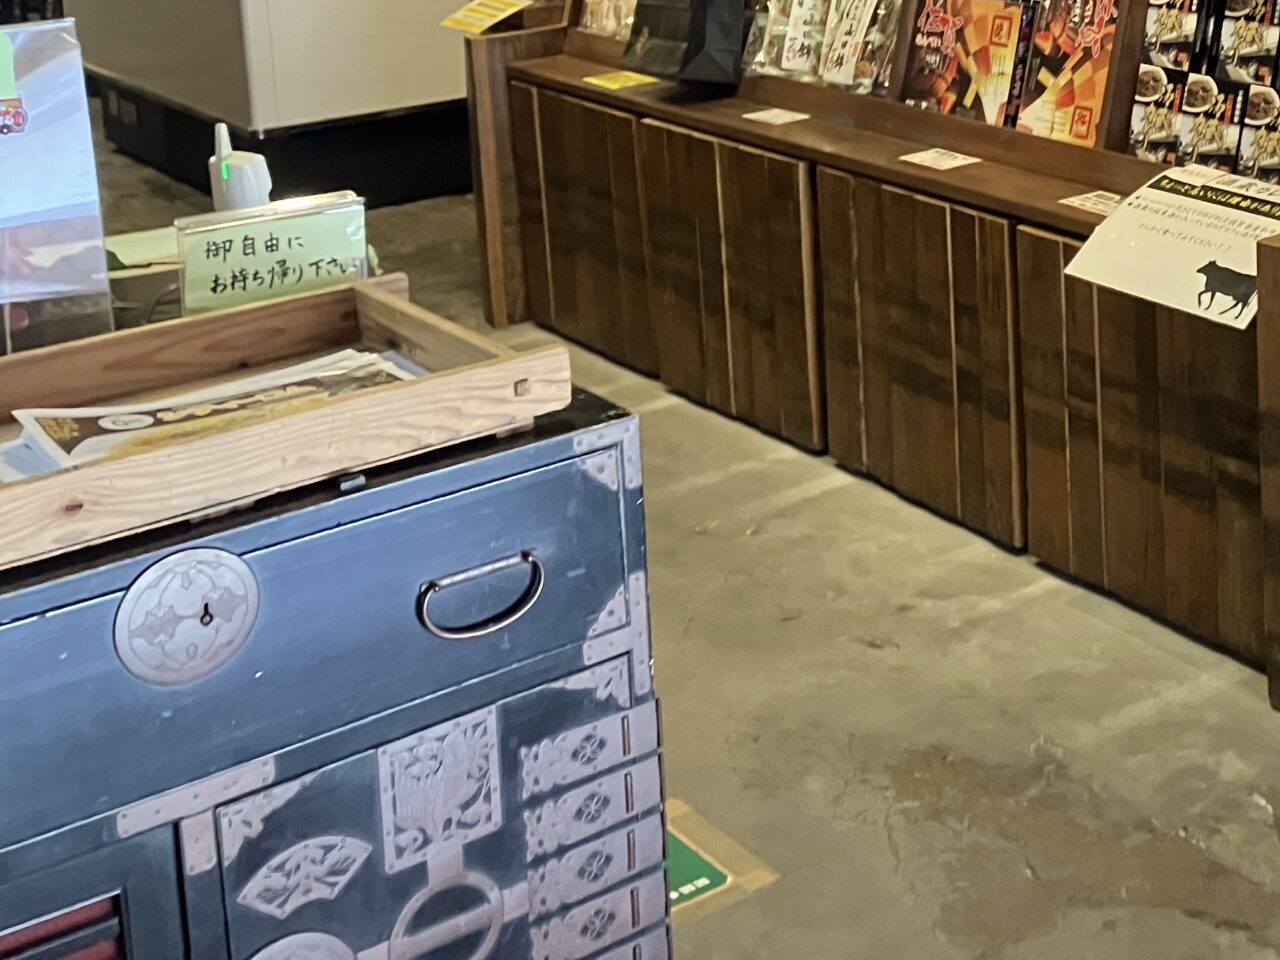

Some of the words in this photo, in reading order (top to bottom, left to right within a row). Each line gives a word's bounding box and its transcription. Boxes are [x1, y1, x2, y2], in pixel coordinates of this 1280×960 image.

[203, 233, 305, 262] 御自由に
[210, 256, 358, 296] お持ち帰り下さい
